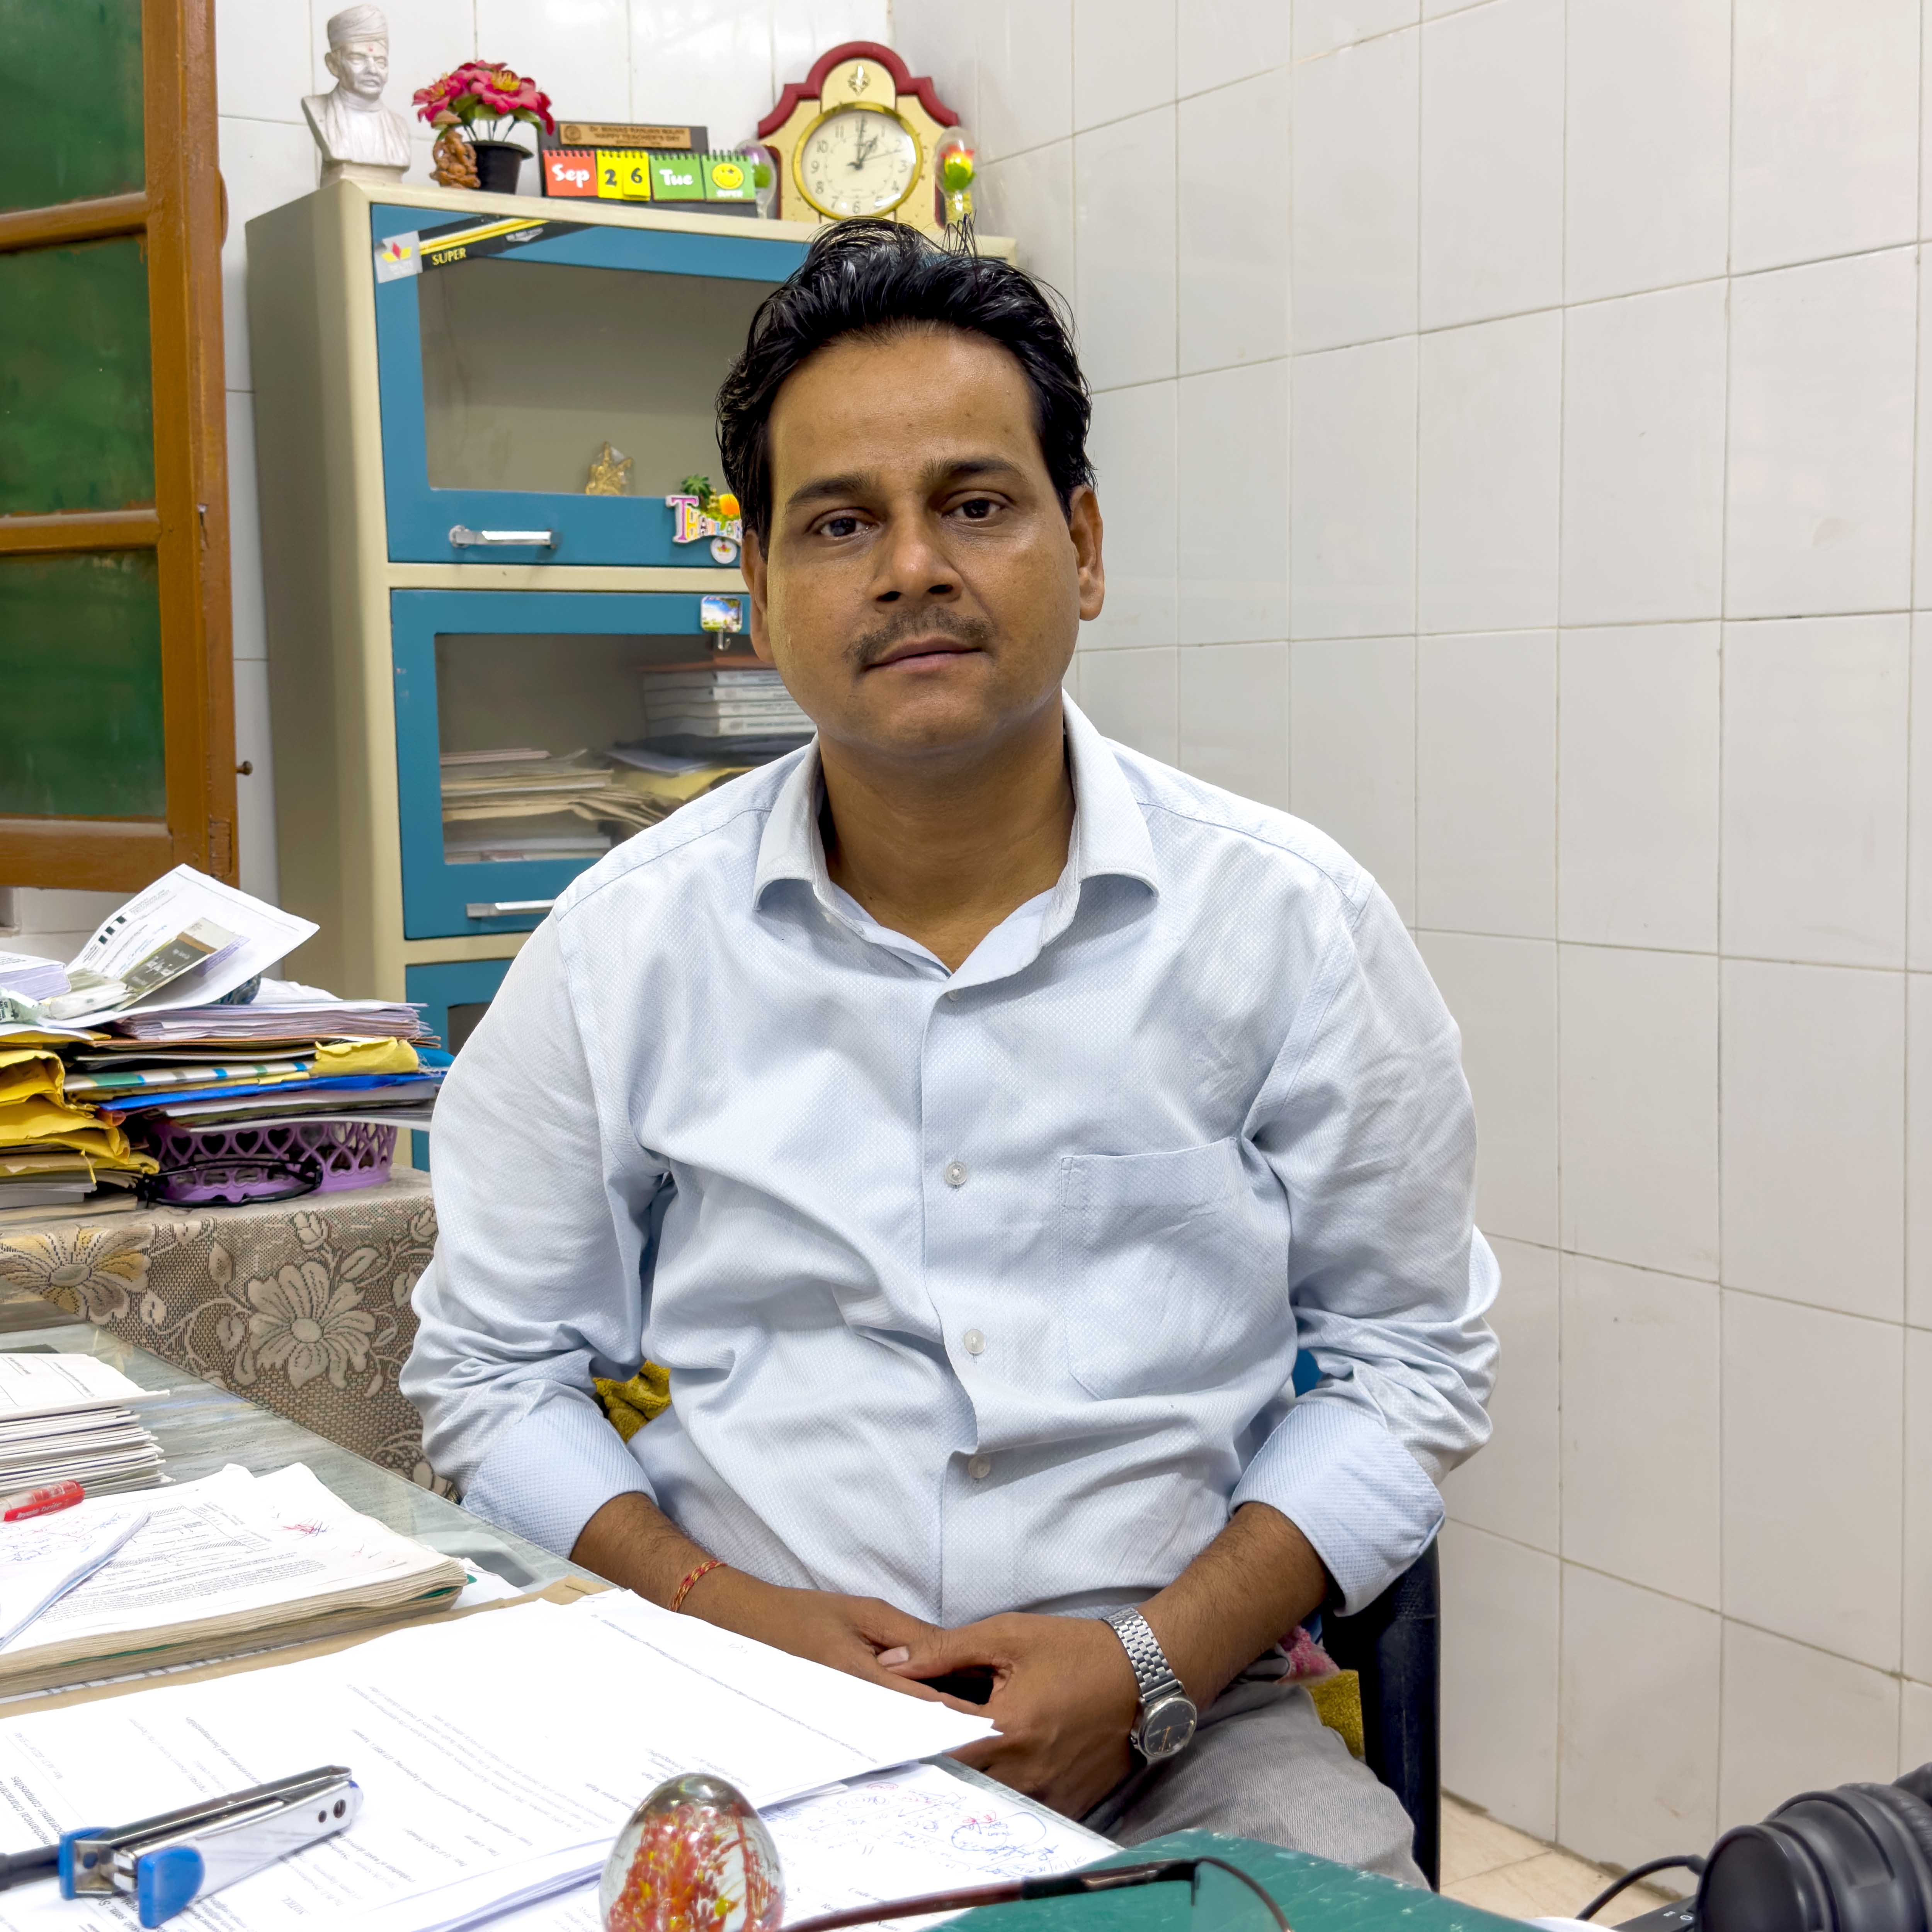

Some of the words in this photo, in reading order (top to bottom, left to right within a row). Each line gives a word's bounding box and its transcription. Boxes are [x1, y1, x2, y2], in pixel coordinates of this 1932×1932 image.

[552, 163, 590, 188] Sep
[604, 169, 617, 186] 2
[631, 167, 642, 184] 6
[659, 168, 693, 186] Tue
[431, 248, 466, 266] SUPER
[666, 496, 742, 543] THAILAN
[10, 1776, 43, 1808] composites
